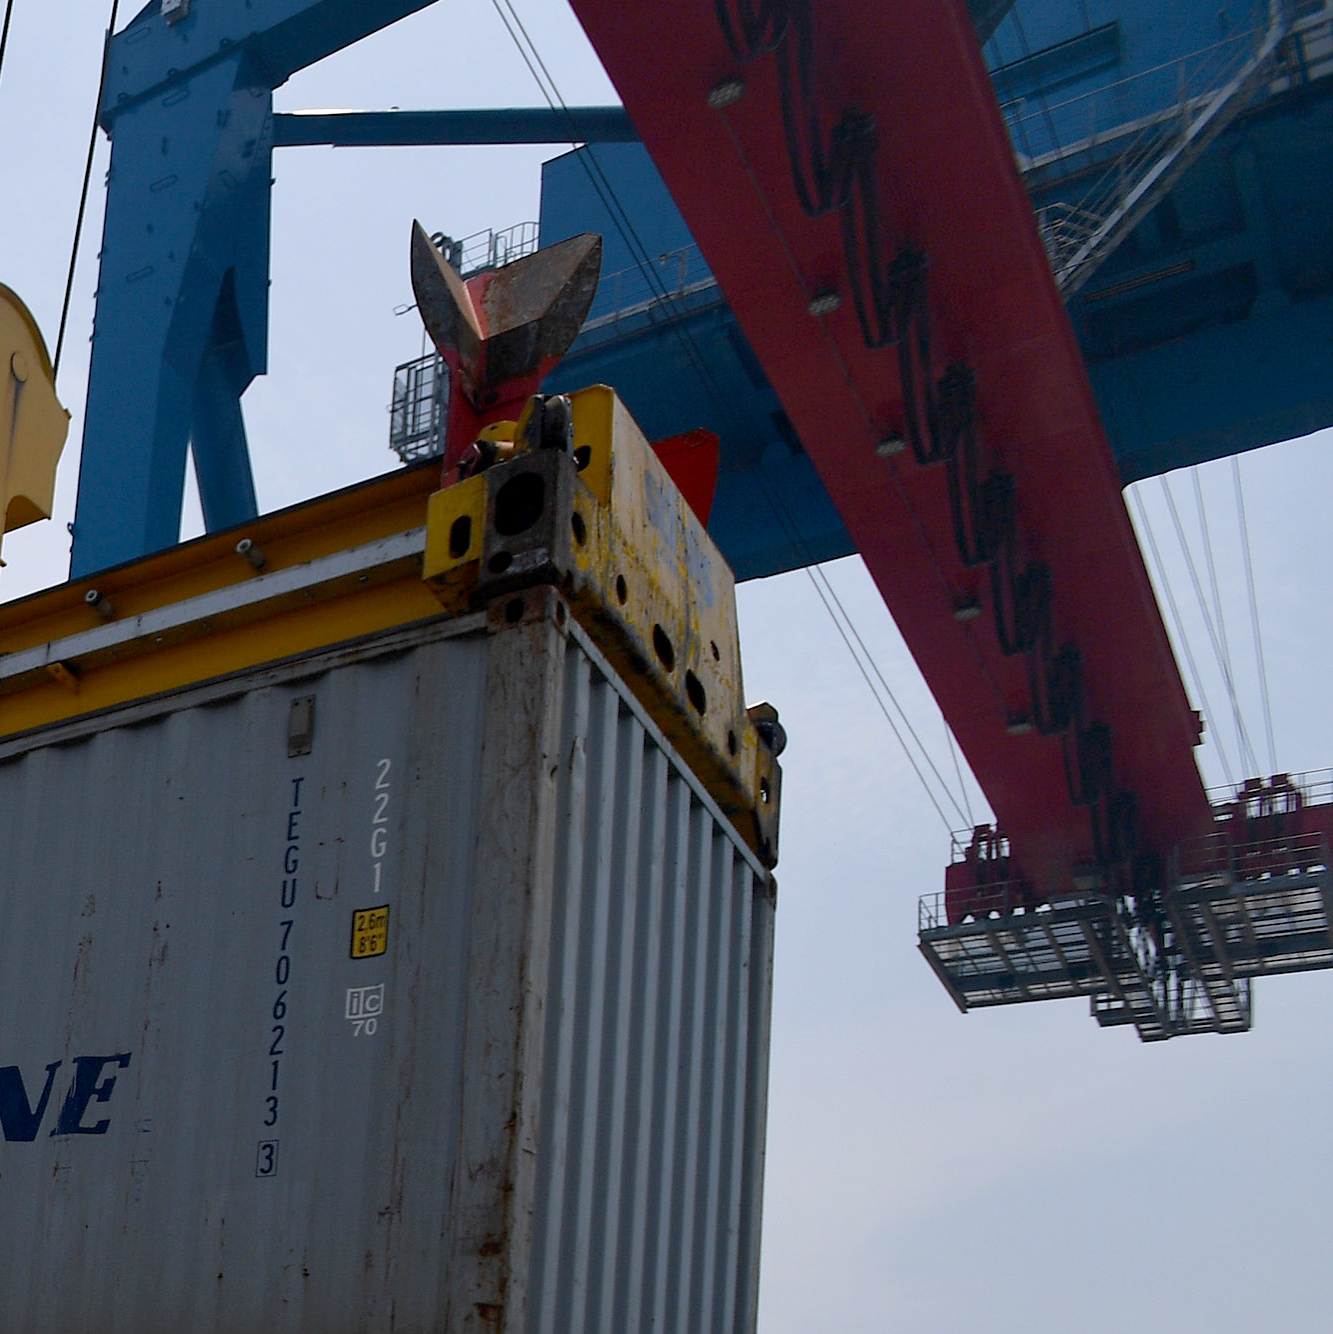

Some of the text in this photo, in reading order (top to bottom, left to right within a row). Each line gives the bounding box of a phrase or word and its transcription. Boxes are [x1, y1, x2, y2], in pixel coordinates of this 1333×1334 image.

[279, 777, 306, 909] TEGU
[370, 758, 391, 893] 22G1
[262, 919, 295, 1127] 706213
[351, 1017, 378, 1038] 70
